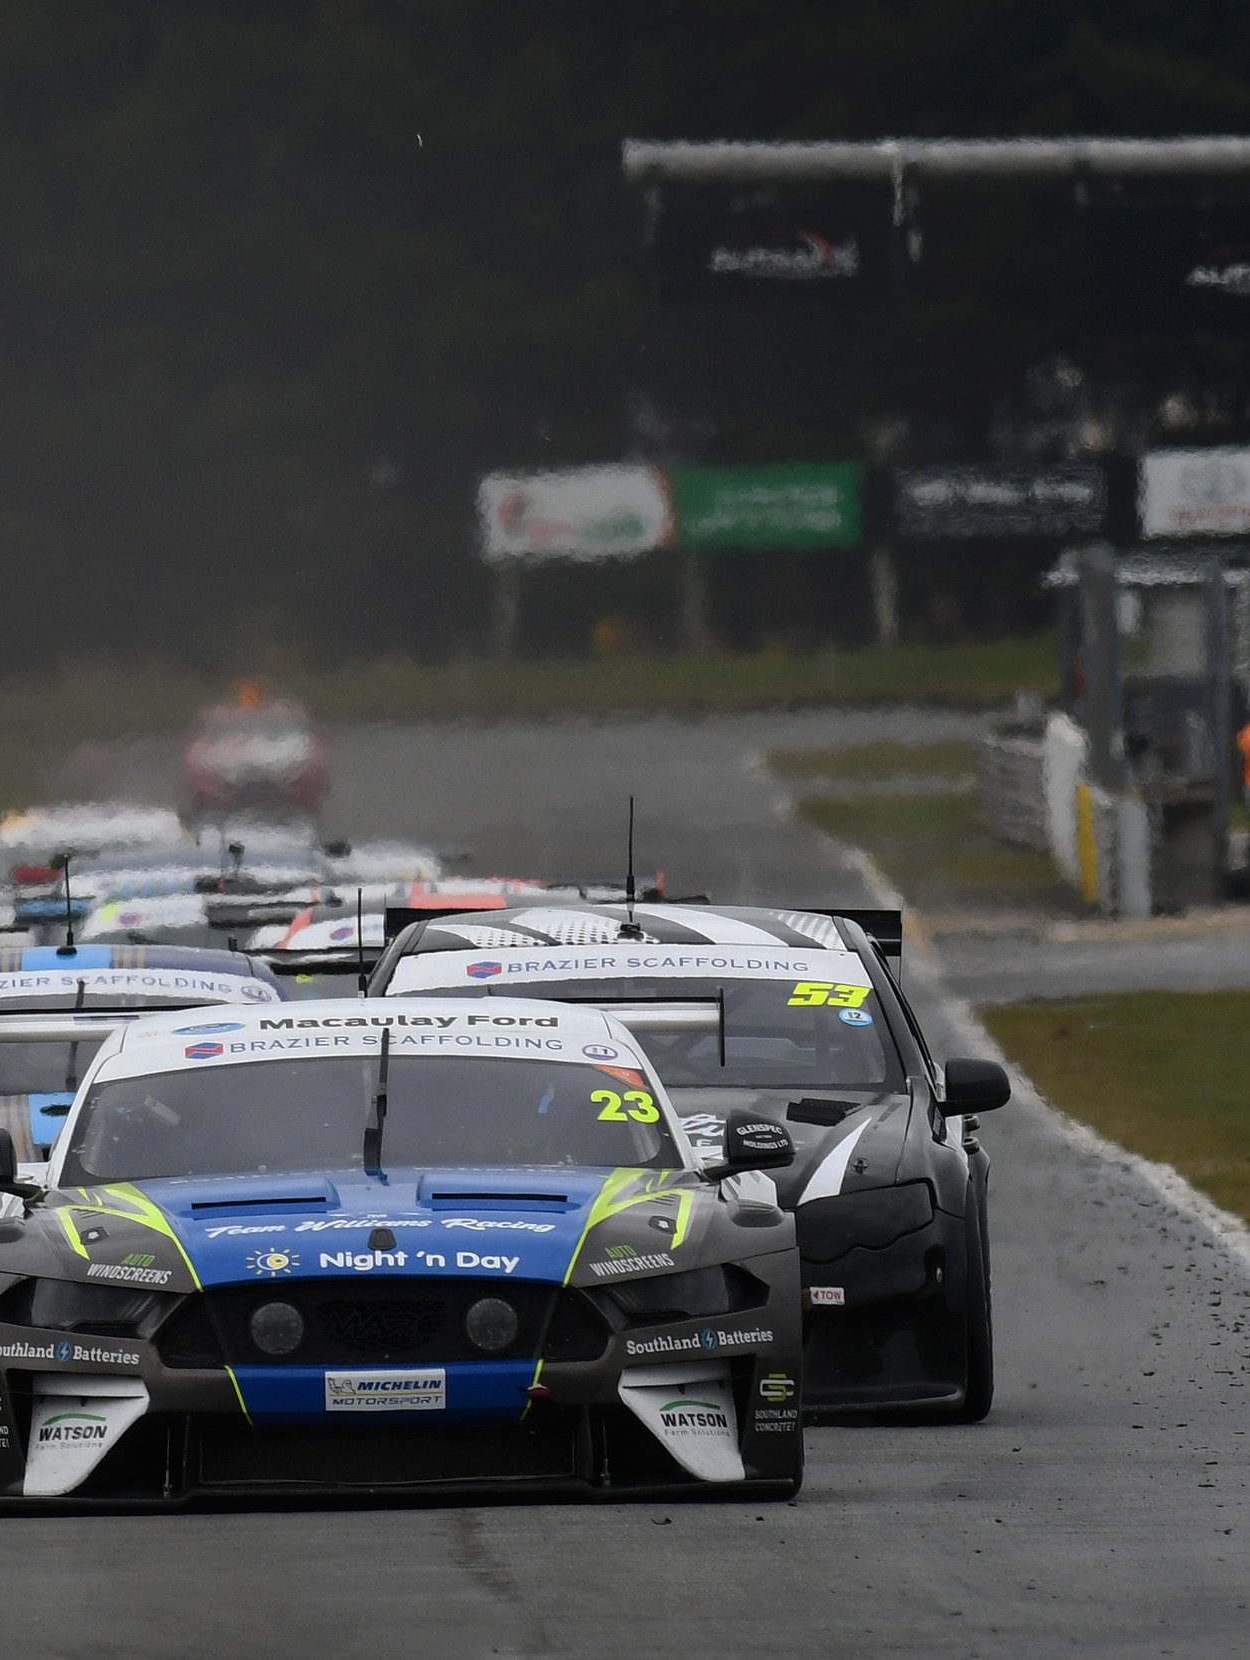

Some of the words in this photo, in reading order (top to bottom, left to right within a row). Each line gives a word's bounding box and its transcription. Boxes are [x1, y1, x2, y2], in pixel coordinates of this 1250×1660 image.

[507, 957, 617, 974] BRAZIER
[627, 956, 809, 973] SCAFFOLDING
[61, 974, 232, 994] SCAFFOLDING
[787, 983, 871, 1008] 53
[259, 1014, 458, 1030] Macaulay
[467, 1014, 559, 1028] Ford
[230, 1035, 350, 1054] BRAZIER
[362, 1034, 563, 1051] SCAFFOLDING
[590, 1089, 660, 1124] 23
[736, 1123, 784, 1136] GLENSPEC
[742, 1139, 778, 1150] HOLDINGS
[778, 1138, 789, 1148] LTD
[204, 1225, 286, 1239] Team
[294, 1216, 434, 1233] Williams
[441, 1217, 557, 1234] Racing
[604, 1244, 638, 1257] AUTO
[121, 1253, 156, 1266] AUTO
[319, 1250, 409, 1272] Night
[456, 1251, 520, 1273] Day
[589, 1253, 675, 1278] WINDSCREENS
[87, 1263, 173, 1285] WINDSCREENS
[820, 1290, 843, 1302] TOW
[626, 1334, 701, 1356] Southland
[717, 1327, 774, 1346] Batteries
[72, 1345, 140, 1366] Batteries
[356, 1379, 442, 1391] MICHELIN
[331, 1394, 443, 1406] MOTORSPORT
[660, 1413, 728, 1428] WATSON
[754, 1409, 798, 1420] SOUTHLAND
[38, 1425, 108, 1442] WATSON
[664, 1428, 689, 1437] Farm
